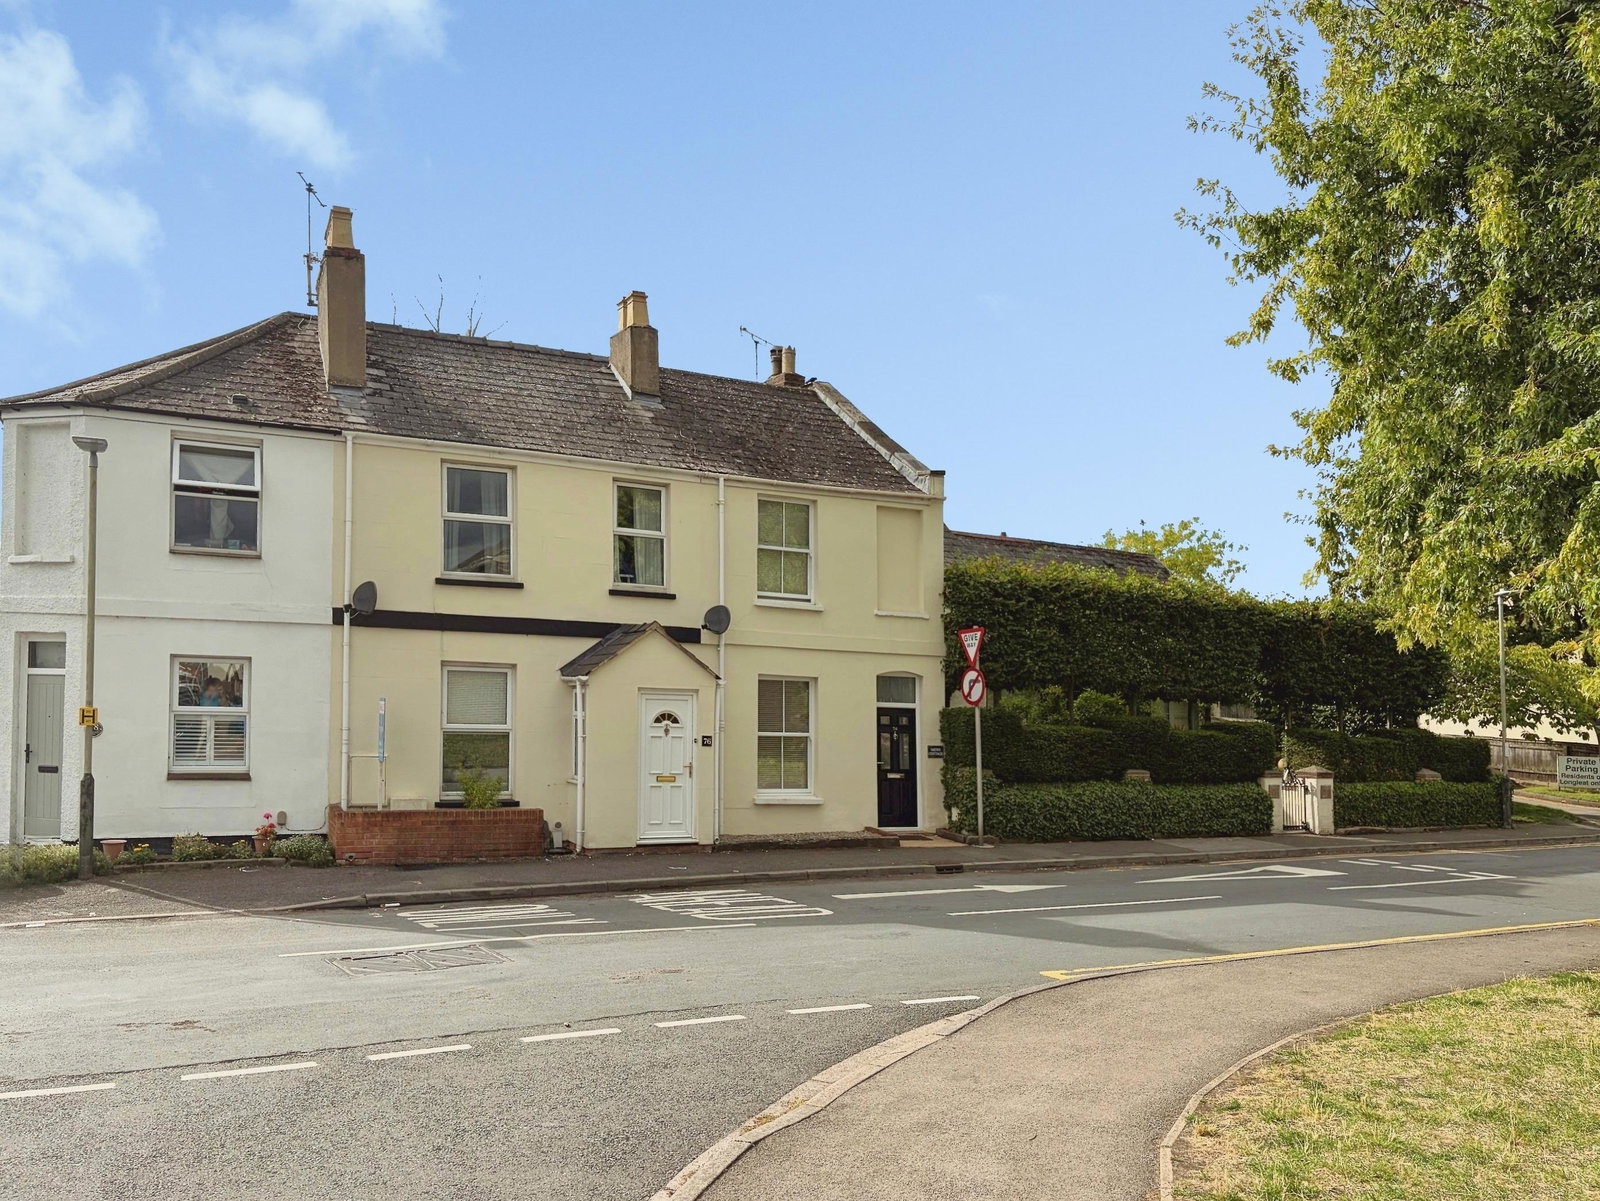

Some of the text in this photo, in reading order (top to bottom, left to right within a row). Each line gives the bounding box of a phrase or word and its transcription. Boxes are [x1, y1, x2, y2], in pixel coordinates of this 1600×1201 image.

[963, 633, 978, 642] GIVE
[703, 737, 712, 745] 76
[1566, 765, 1598, 774] Parking
[396, 904, 609, 932] ONLY
